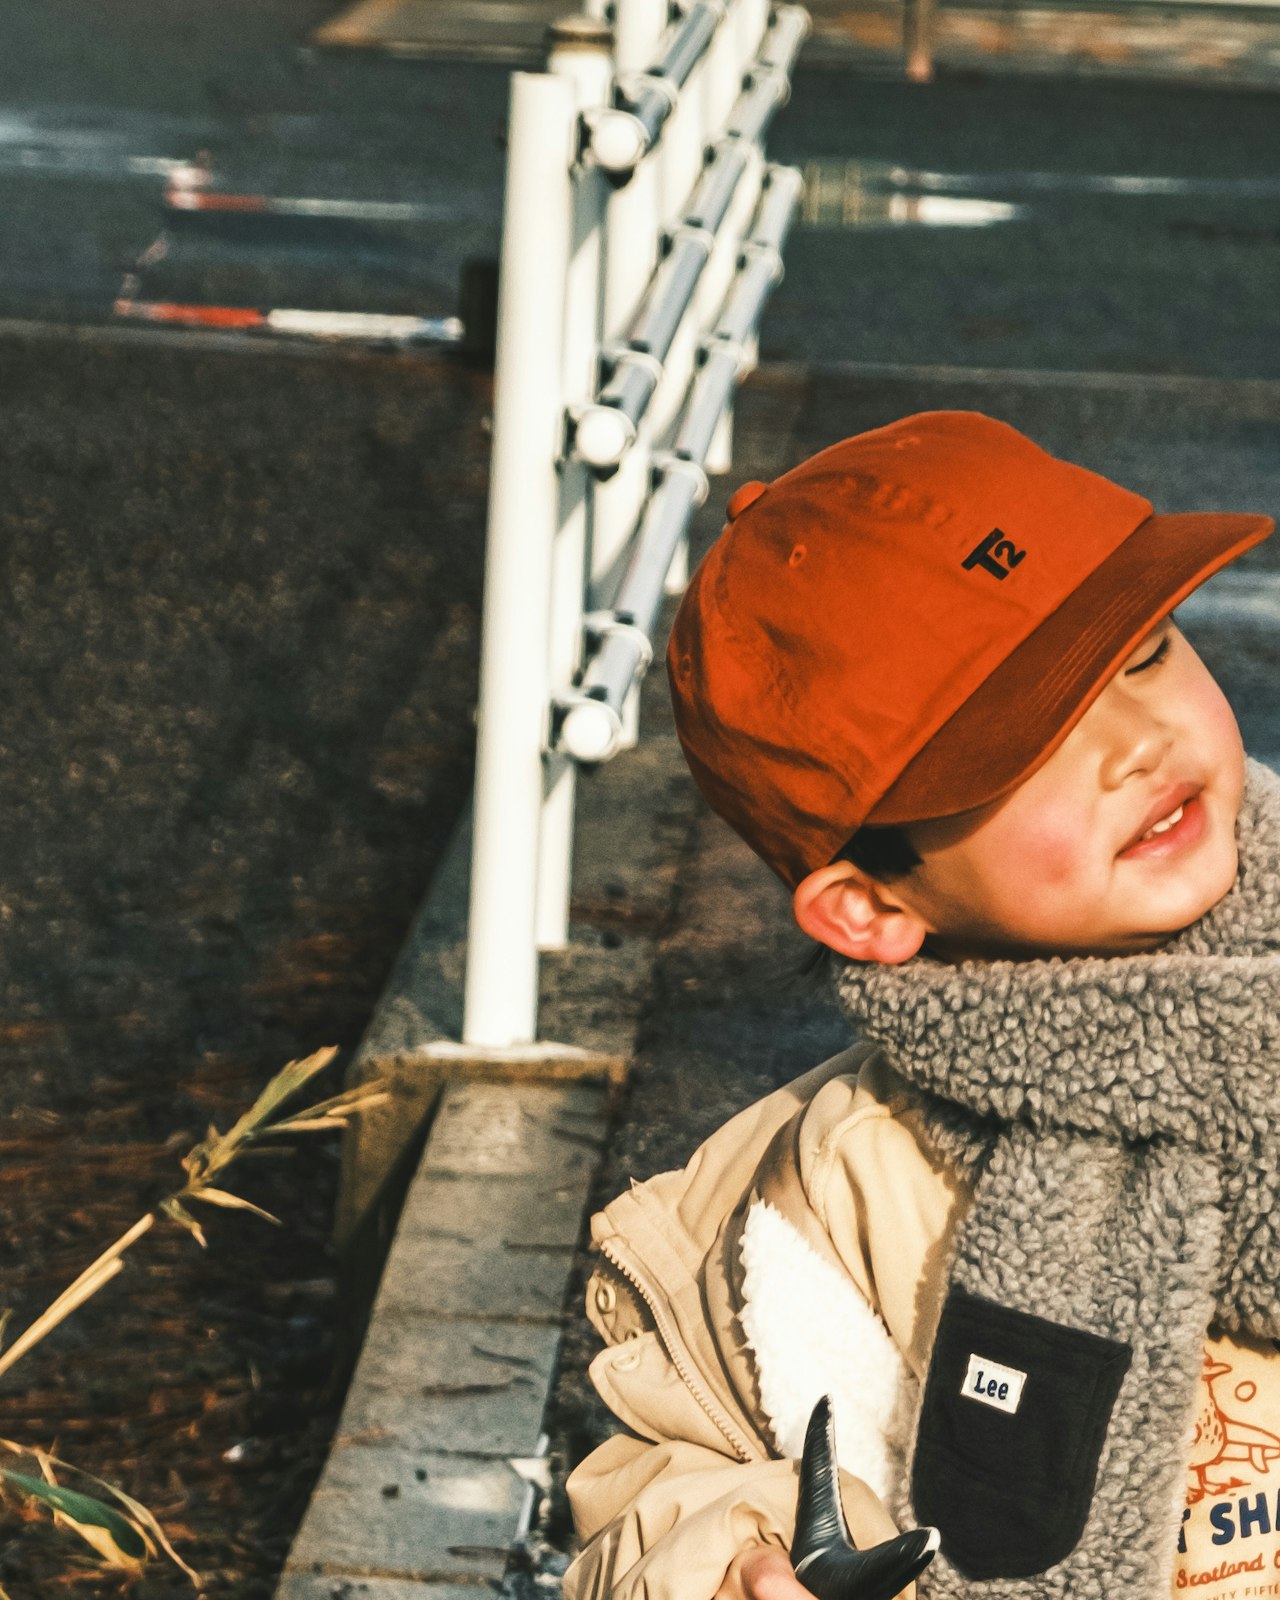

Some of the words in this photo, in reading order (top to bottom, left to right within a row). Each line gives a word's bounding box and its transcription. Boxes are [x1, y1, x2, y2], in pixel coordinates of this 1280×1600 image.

[961, 528, 1027, 581] T2
[974, 1371, 1009, 1400] Lee
[1176, 1553, 1265, 1589] Scotland
